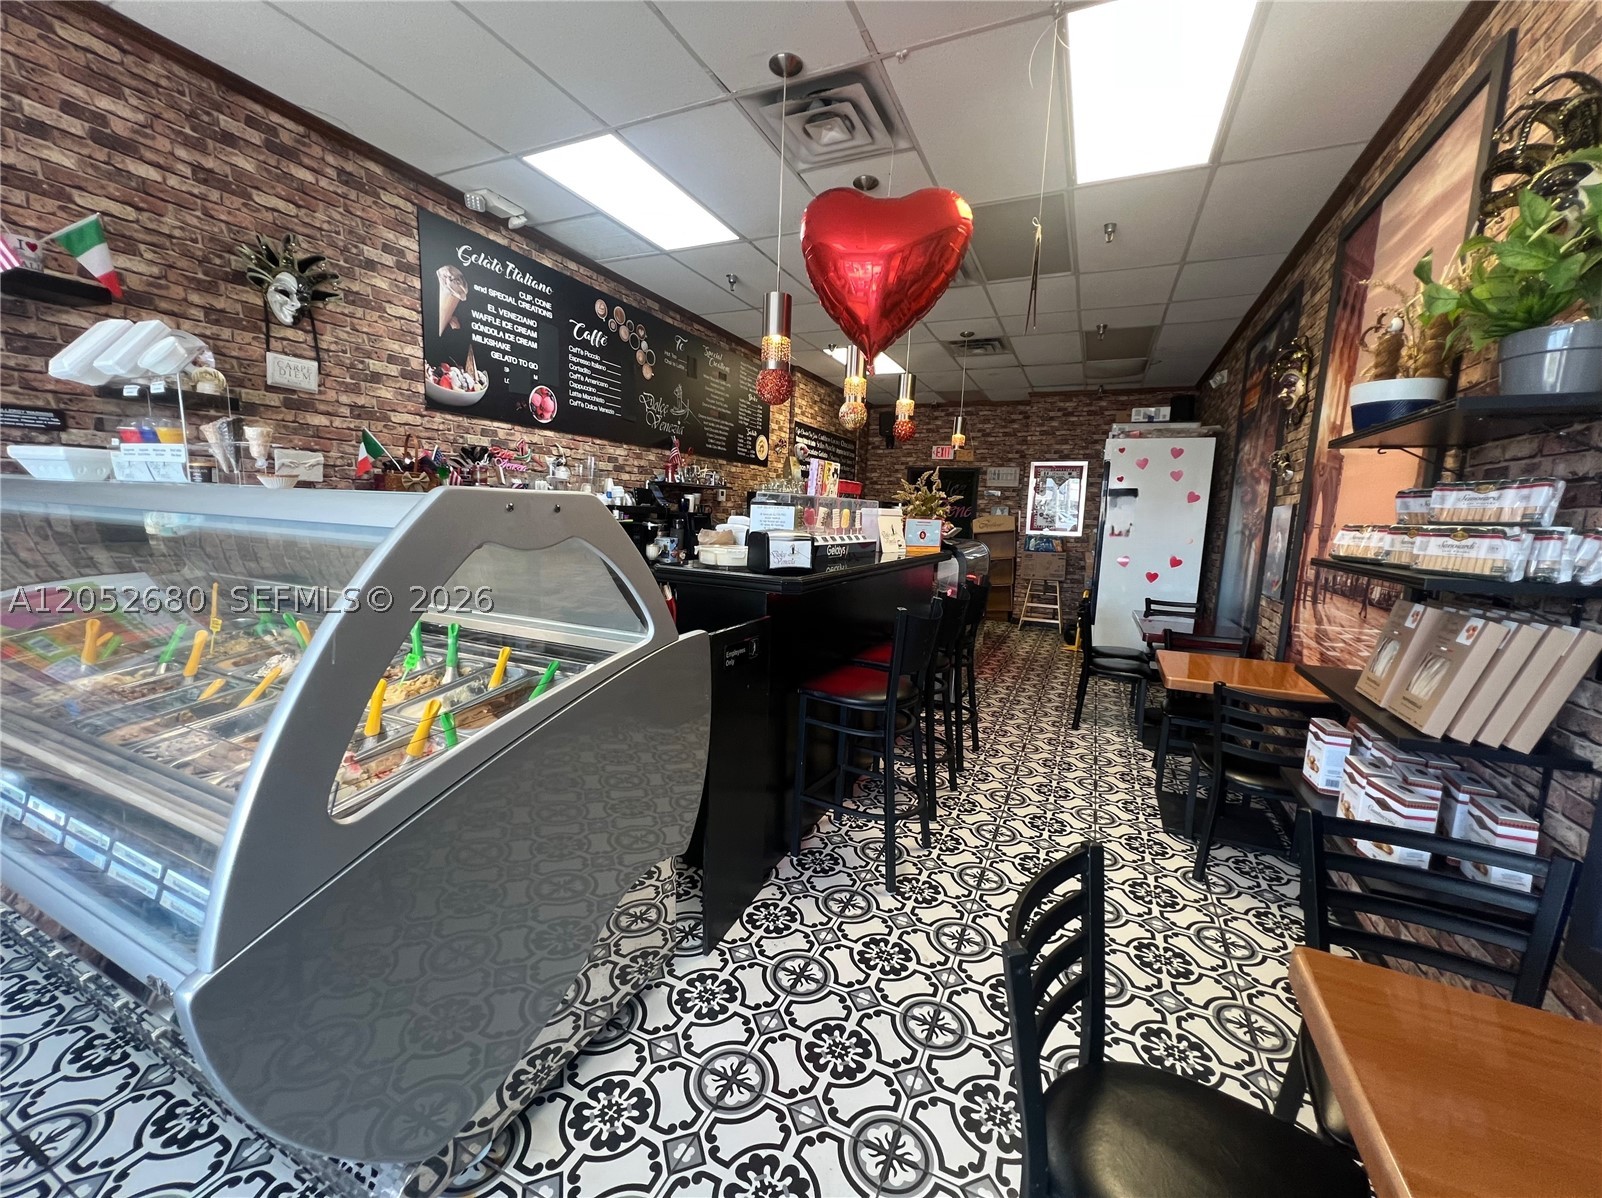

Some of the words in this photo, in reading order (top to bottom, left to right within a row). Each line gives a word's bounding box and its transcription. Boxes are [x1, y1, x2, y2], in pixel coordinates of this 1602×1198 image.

[505, 260, 554, 296] Italiano
[473, 284, 487, 294] and
[488, 288, 517, 306] SPECIAL
[517, 299, 553, 319] CREATIONS
[534, 297, 552, 310] CONE
[471, 309, 502, 327] WAFFLE
[501, 318, 513, 331] ICE
[513, 324, 538, 339] CREAM
[487, 303, 497, 313] EL
[498, 307, 538, 328] VENEZIANO
[471, 333, 512, 352] MILKSHAKE
[505, 333, 516, 343] ICE
[515, 336, 538, 349] CREAM
[277, 360, 313, 373] CARPE
[490, 350, 517, 365] GELATO
[518, 358, 528, 367] TO
[528, 361, 539, 370] GO
[568, 353, 591, 367] Espresso
[591, 361, 607, 371] Italiano
[279, 368, 312, 380] DIEM
[584, 376, 609, 389] Americano
[568, 380, 597, 393] Cappuccino
[568, 389, 582, 399] Latte
[646, 411, 685, 436] Venezia
[935, 446, 952, 458] EXIT
